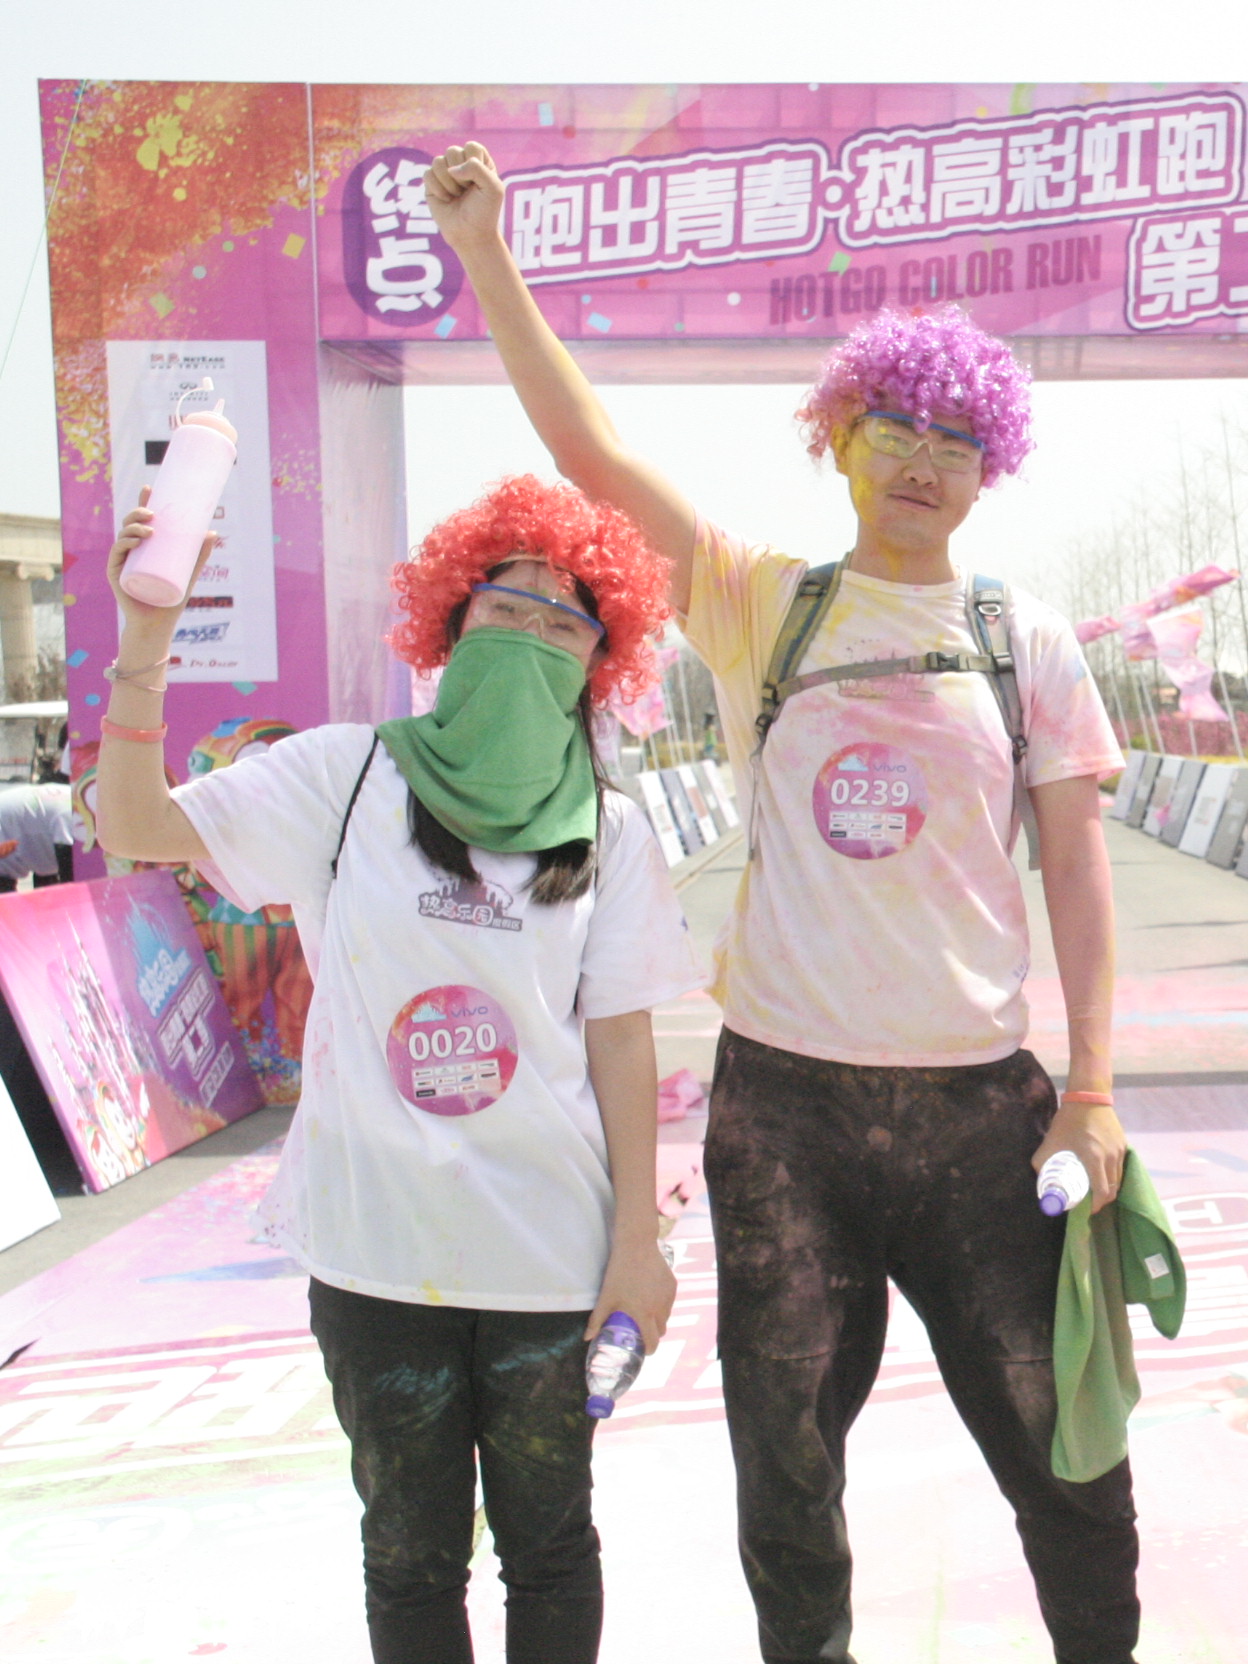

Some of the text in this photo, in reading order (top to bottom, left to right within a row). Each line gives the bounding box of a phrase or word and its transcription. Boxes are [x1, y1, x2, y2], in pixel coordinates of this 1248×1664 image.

[363, 159, 443, 314] 终点
[769, 234, 1102, 326] HOTGO COLOR RUN
[830, 777, 910, 807] 0239
[408, 1022, 497, 1062] 0020
